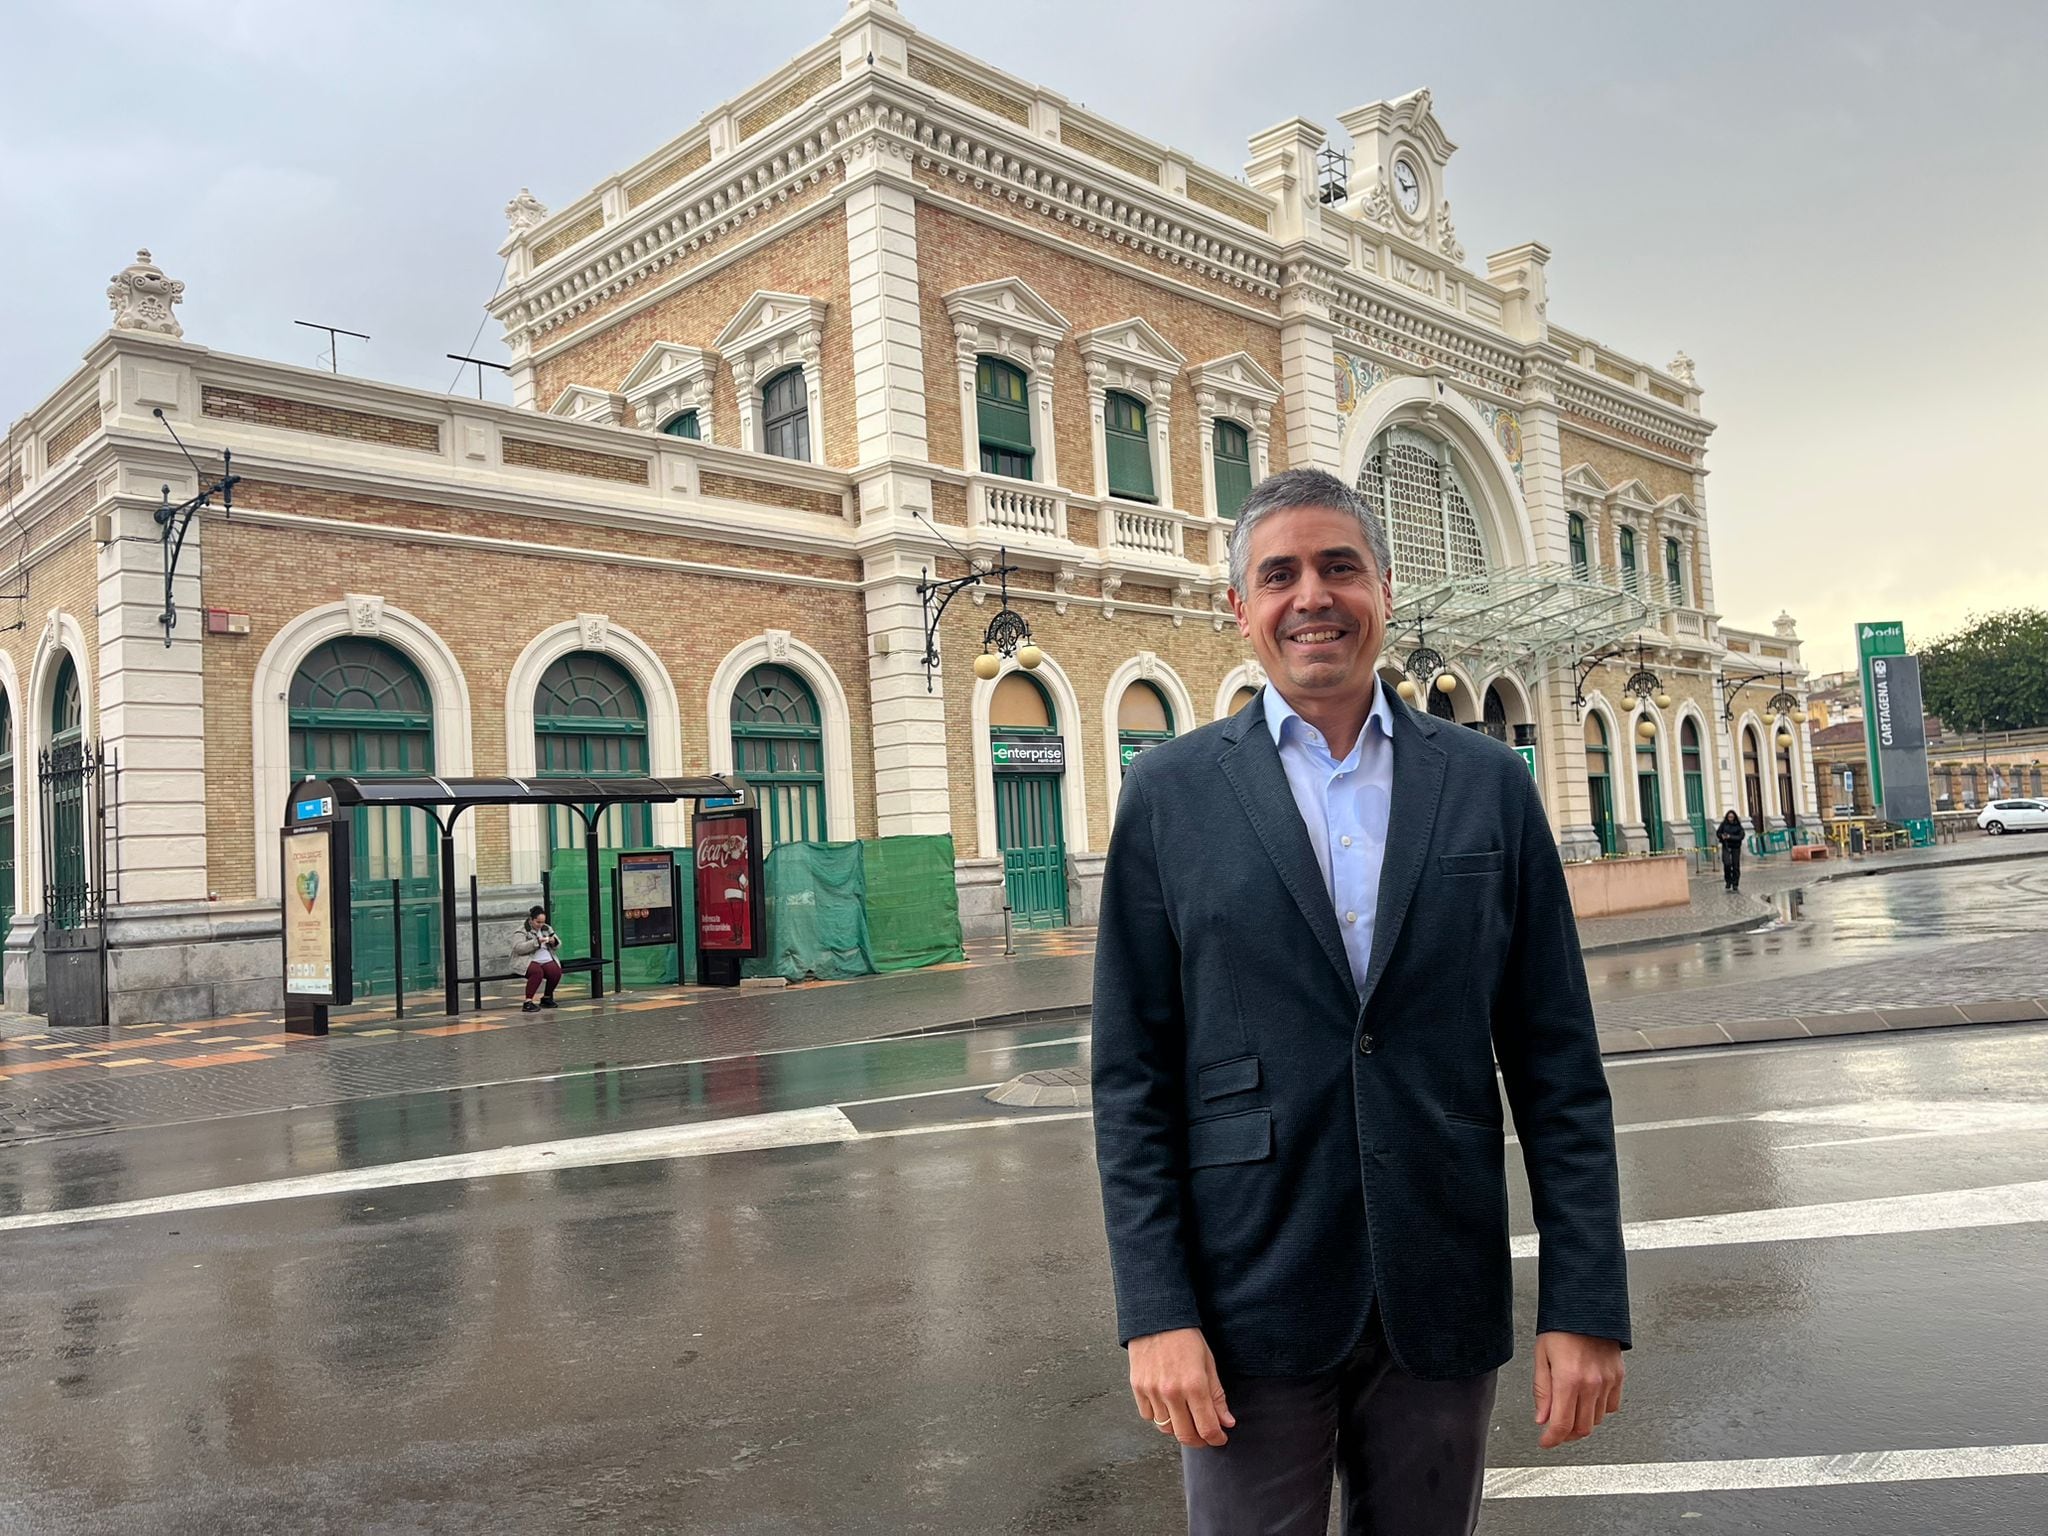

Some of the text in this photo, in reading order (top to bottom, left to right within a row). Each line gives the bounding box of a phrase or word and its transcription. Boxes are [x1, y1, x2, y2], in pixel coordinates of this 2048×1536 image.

[1875, 626, 1900, 636] adif
[1877, 681, 1893, 745] CARTAGENA
[996, 747, 1062, 762] enterprise
